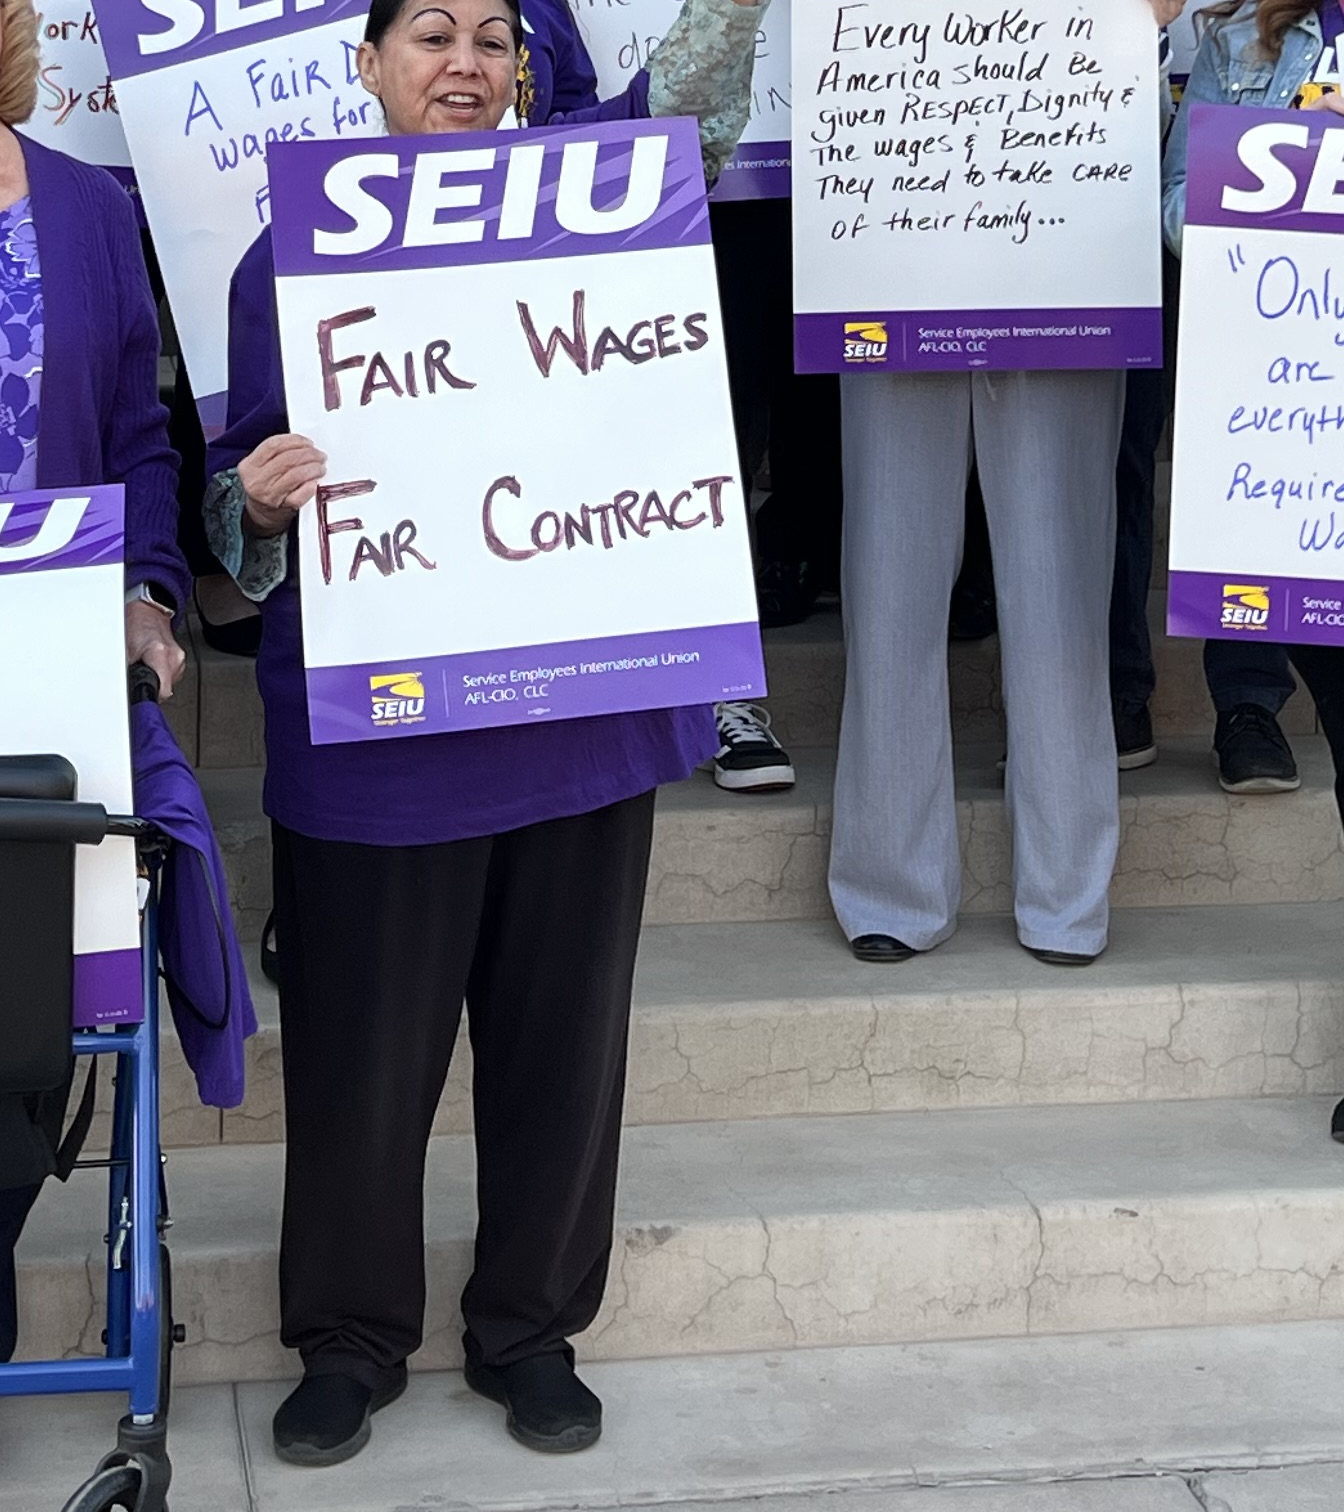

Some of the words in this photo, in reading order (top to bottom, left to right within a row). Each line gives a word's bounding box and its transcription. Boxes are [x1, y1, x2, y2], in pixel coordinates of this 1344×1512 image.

[833, 4, 931, 64] Every
[1065, 6, 1094, 40] in
[817, 60, 941, 96] America
[952, 51, 1049, 86] should
[1068, 51, 1102, 75] Be
[185, 80, 223, 137] A
[333, 96, 371, 135] for
[811, 106, 886, 144] given
[1019, 81, 1121, 120] Dignity
[810, 141, 861, 167] The
[873, 134, 954, 167] wages
[1000, 121, 1107, 151] Benefits
[313, 134, 669, 256] SEIU
[815, 173, 875, 204] They
[891, 170, 950, 195] need
[963, 164, 985, 188] to
[882, 208, 956, 232] their
[843, 343, 888, 358] SEIU
[1267, 356, 1336, 386] are
[1220, 608, 1268, 626] SEIU
[1302, 596, 1341, 611] Service
[463, 671, 506, 688] Service
[510, 663, 577, 686] Employees
[580, 654, 658, 675] International
[662, 650, 700, 666] Union
[371, 698, 425, 720] SEIU
[524, 684, 549, 700] CLC
